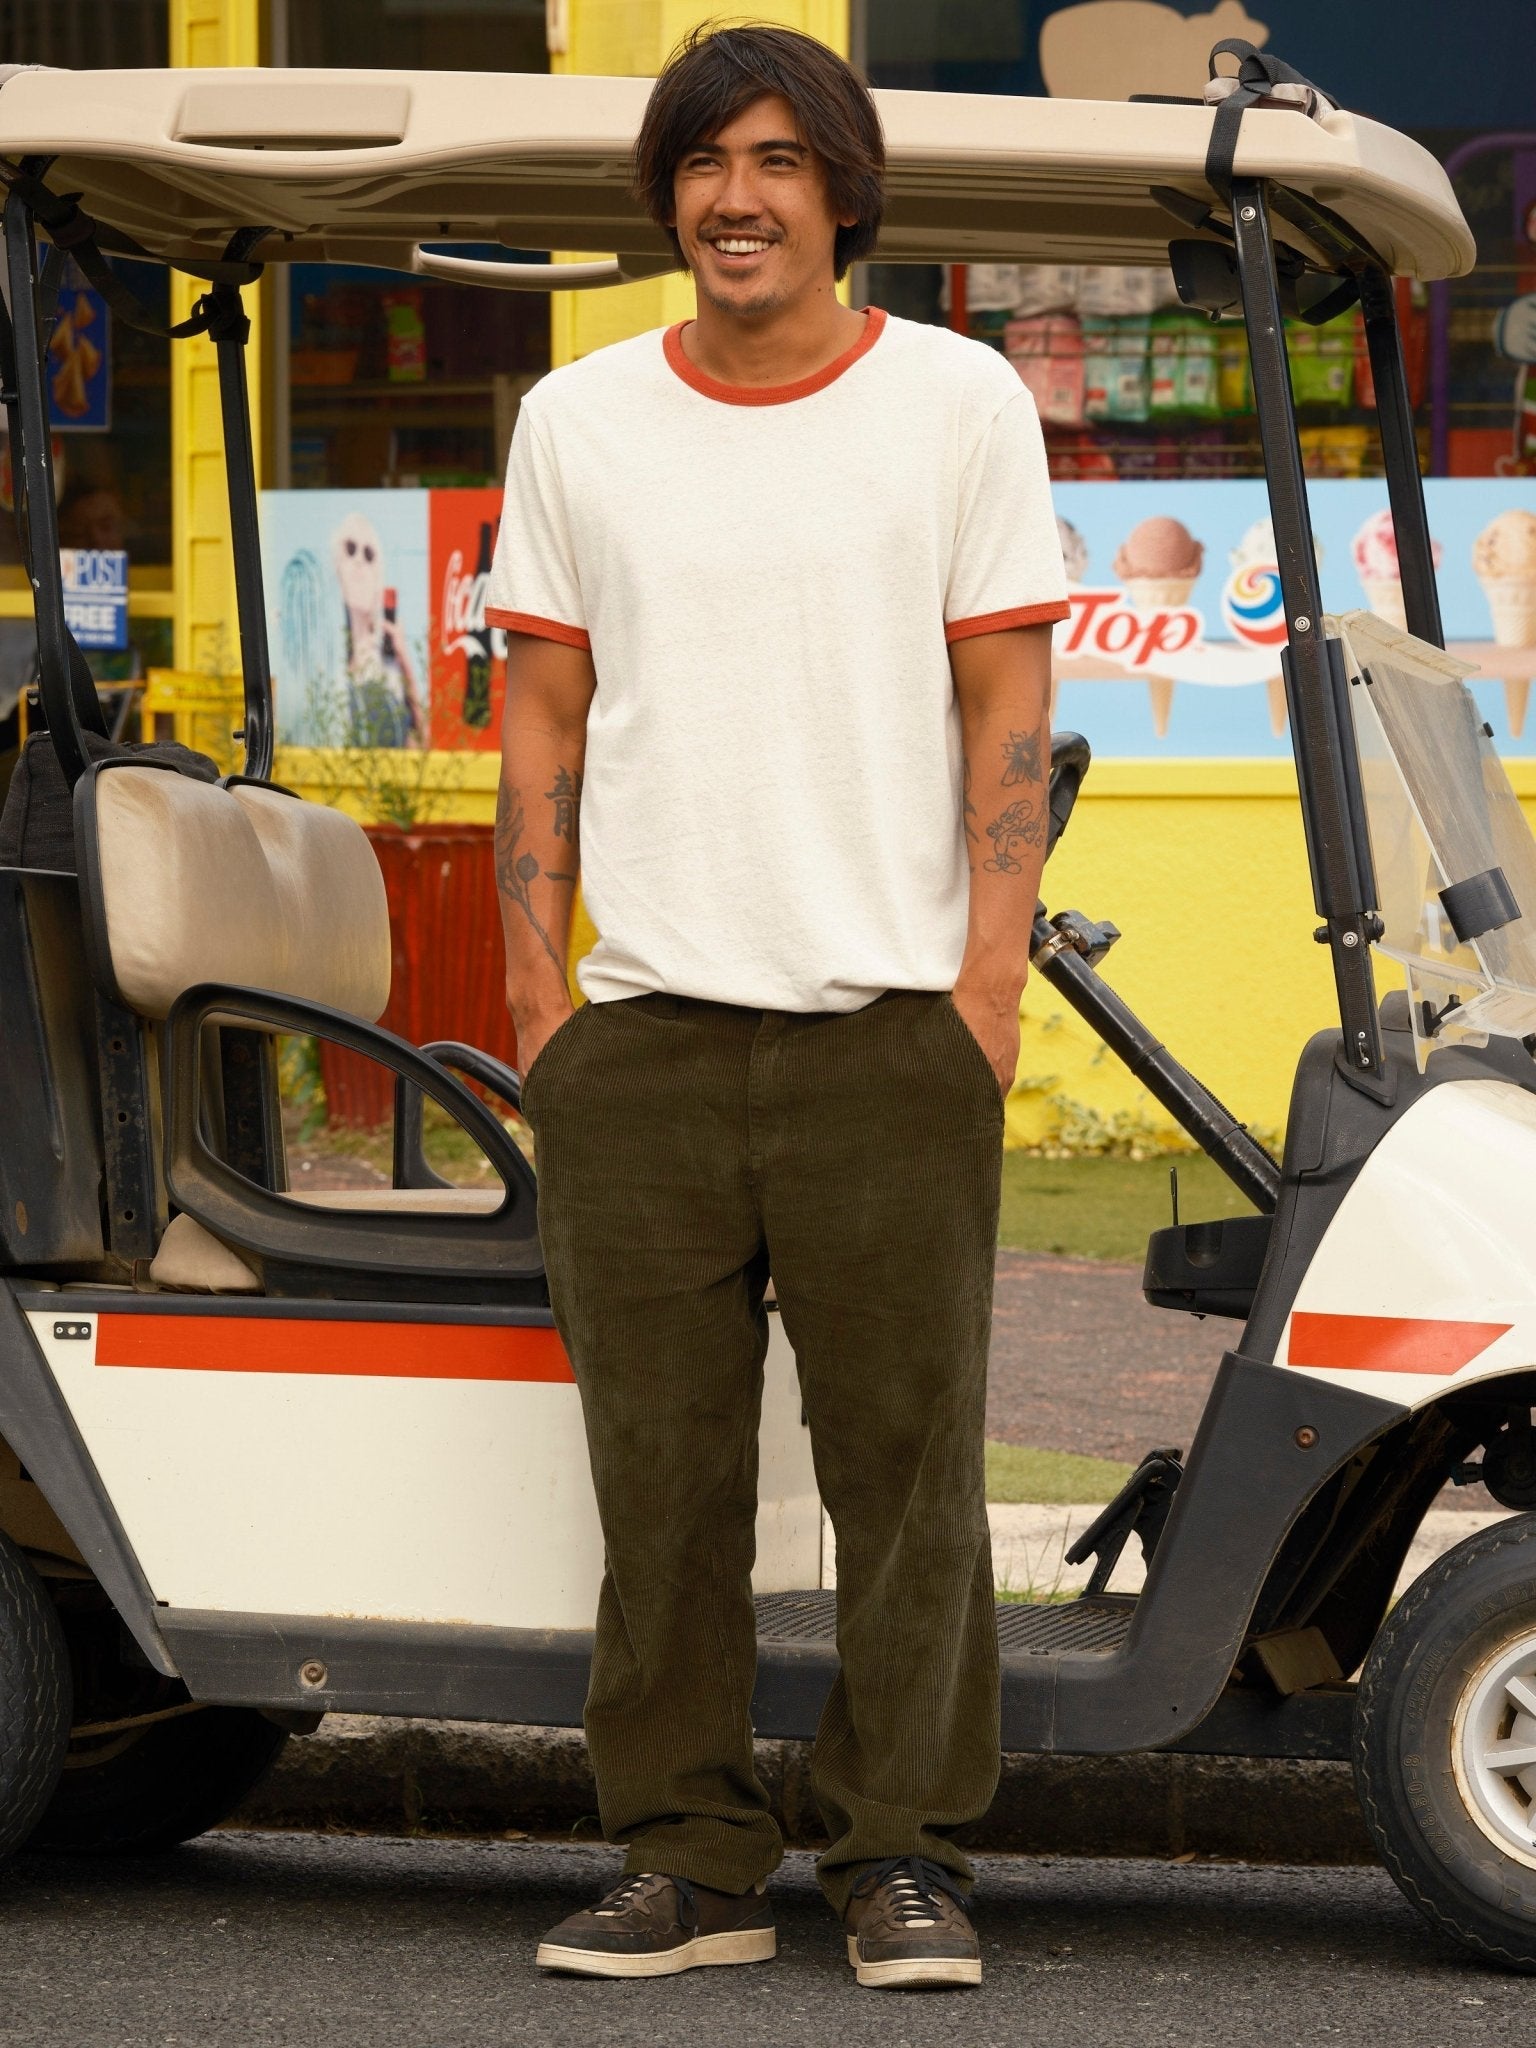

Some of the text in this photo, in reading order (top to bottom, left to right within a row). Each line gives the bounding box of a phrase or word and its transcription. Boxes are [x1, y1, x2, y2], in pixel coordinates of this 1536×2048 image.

[75, 549, 127, 586] POST
[65, 605, 116, 631] FREE
[1065, 593, 1198, 665] Top
